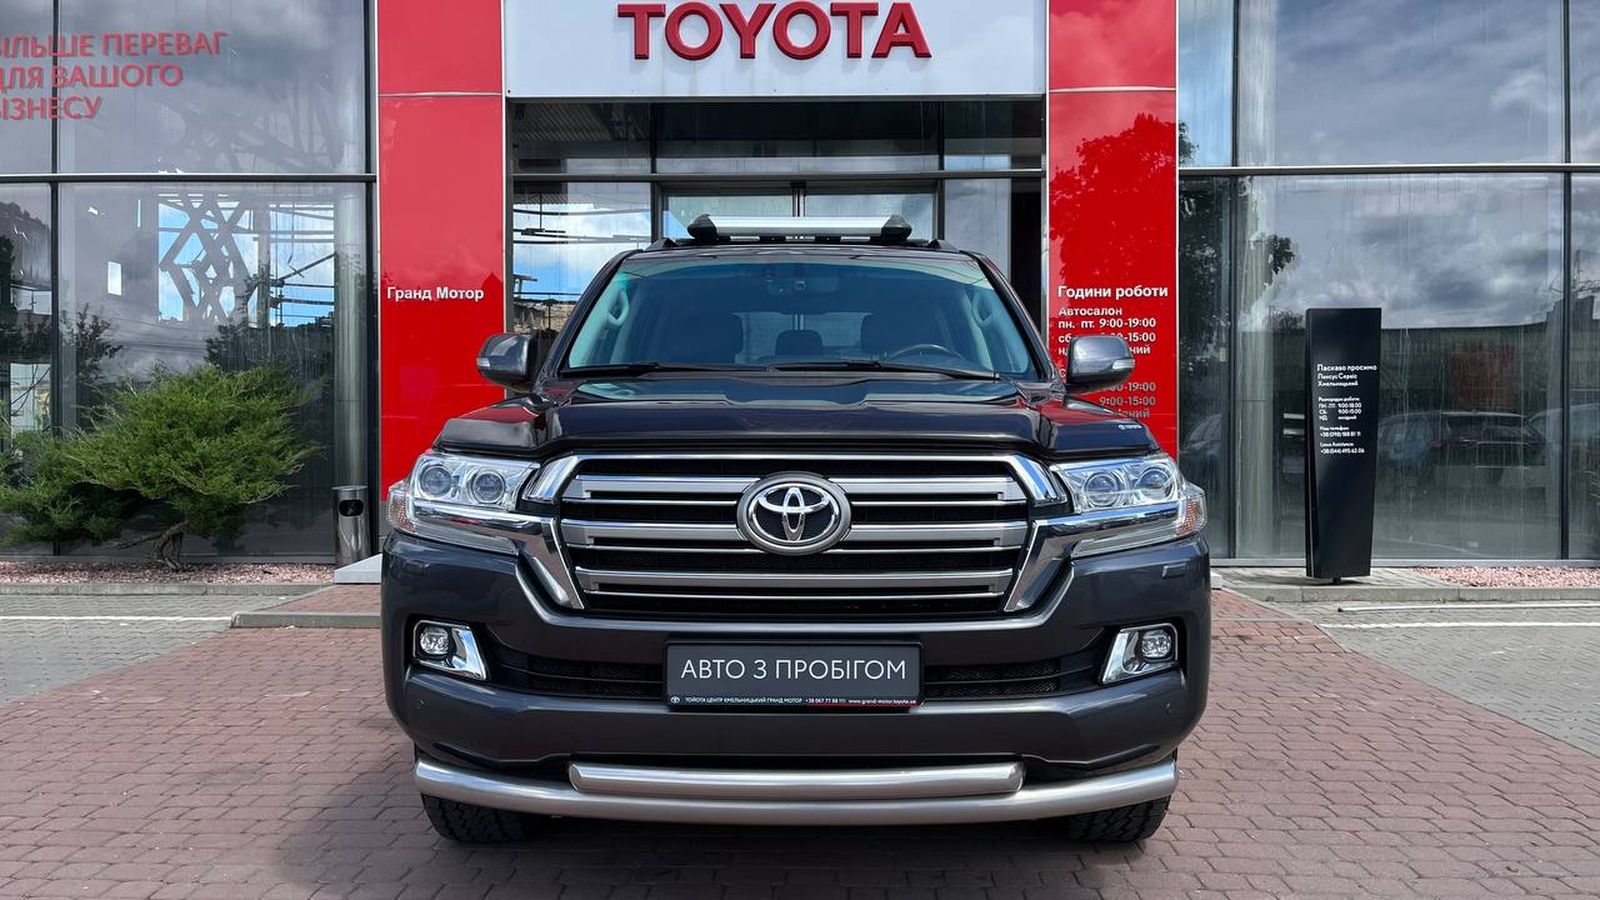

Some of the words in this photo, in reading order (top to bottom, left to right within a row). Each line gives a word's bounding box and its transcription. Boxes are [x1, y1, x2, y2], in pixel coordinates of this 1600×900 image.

[617, 2, 932, 61] TOYOTA
[0, 35, 94, 58] ІЛЬШЕ
[101, 31, 228, 57] ПЕРЕВАГ
[52, 63, 183, 88] ВАШОГО
[0, 96, 102, 121] ІЗНЕСУ
[387, 286, 432, 302] Гранд
[436, 286, 484, 302] Мотор
[1058, 285, 1112, 299] Години
[1115, 285, 1168, 300] роботи
[1059, 307, 1123, 316] Автосалон
[1099, 318, 1156, 328] 9:00-19:00
[1099, 396, 1156, 406] 9:00-15:00
[680, 659, 745, 679] АВТО
[753, 659, 767, 679] З
[776, 659, 906, 679] ПРОБІГОМ
